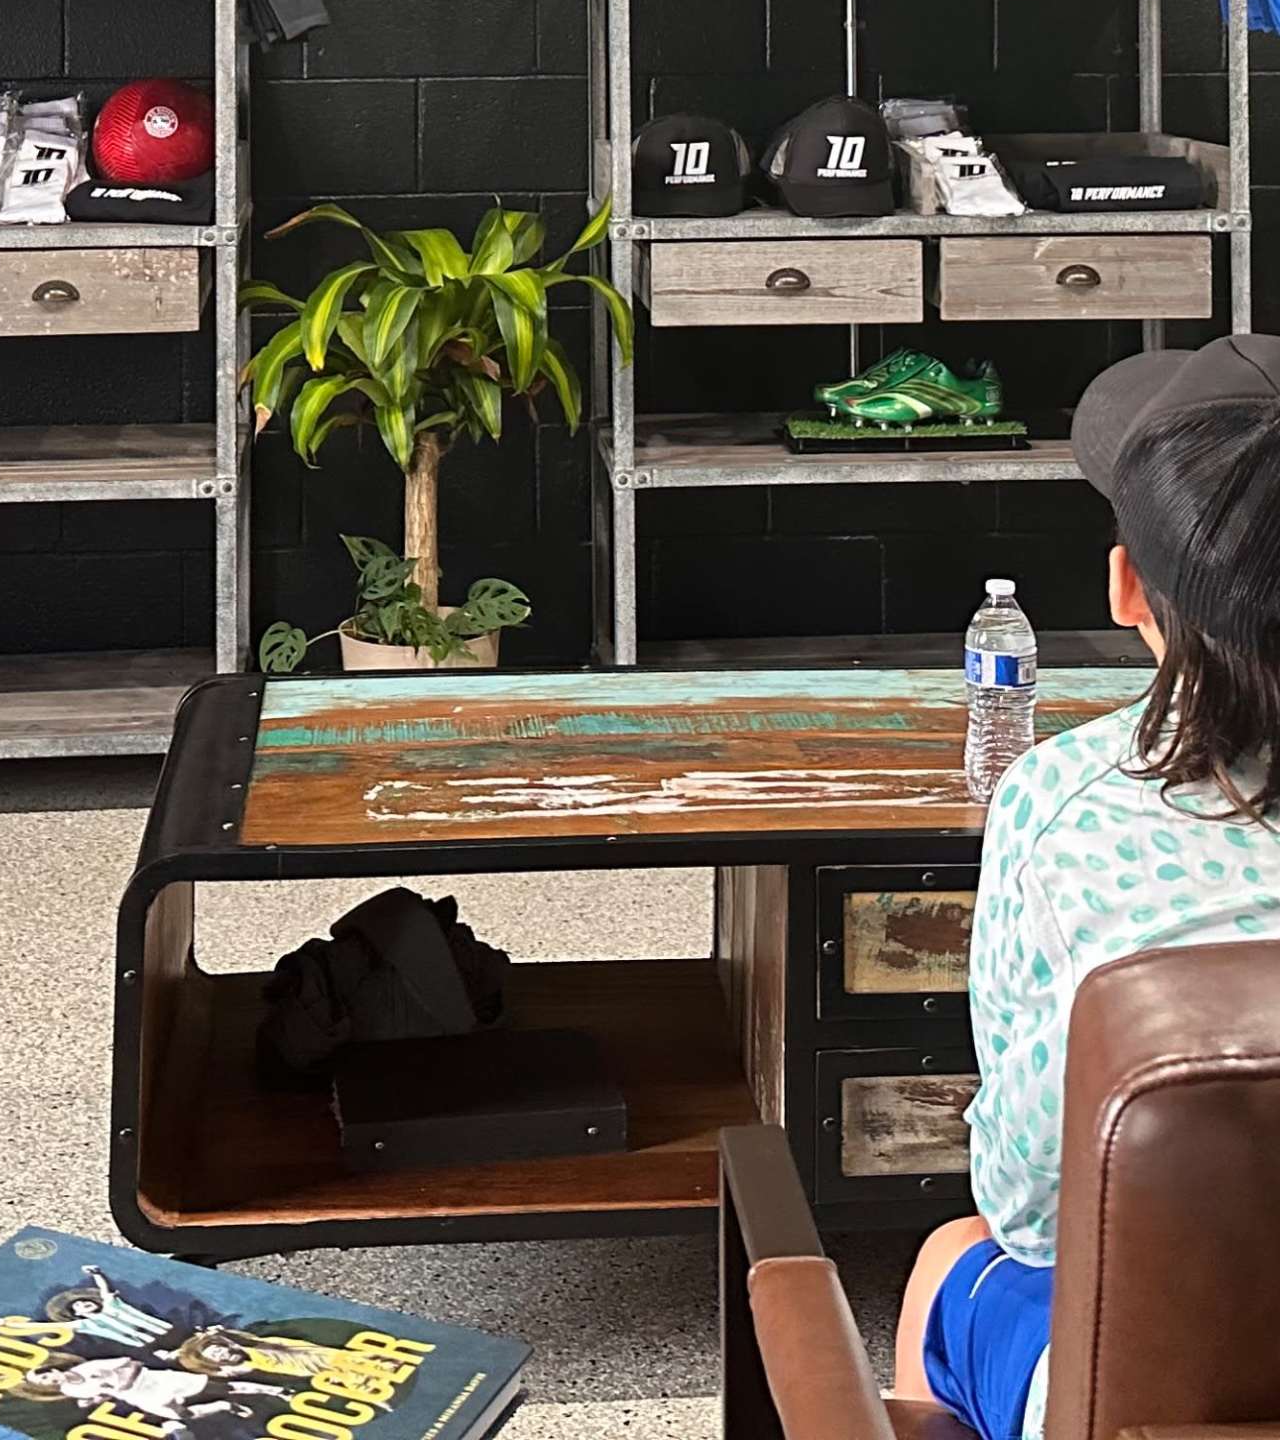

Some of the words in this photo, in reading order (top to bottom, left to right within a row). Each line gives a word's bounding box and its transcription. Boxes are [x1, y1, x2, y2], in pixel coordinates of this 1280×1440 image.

[670, 142, 710, 175] 10
[826, 136, 865, 169] 10
[21, 168, 54, 184] 10
[1085, 185, 1165, 200] PERFORMANCE
[256, 1331, 436, 1440] OCCER
